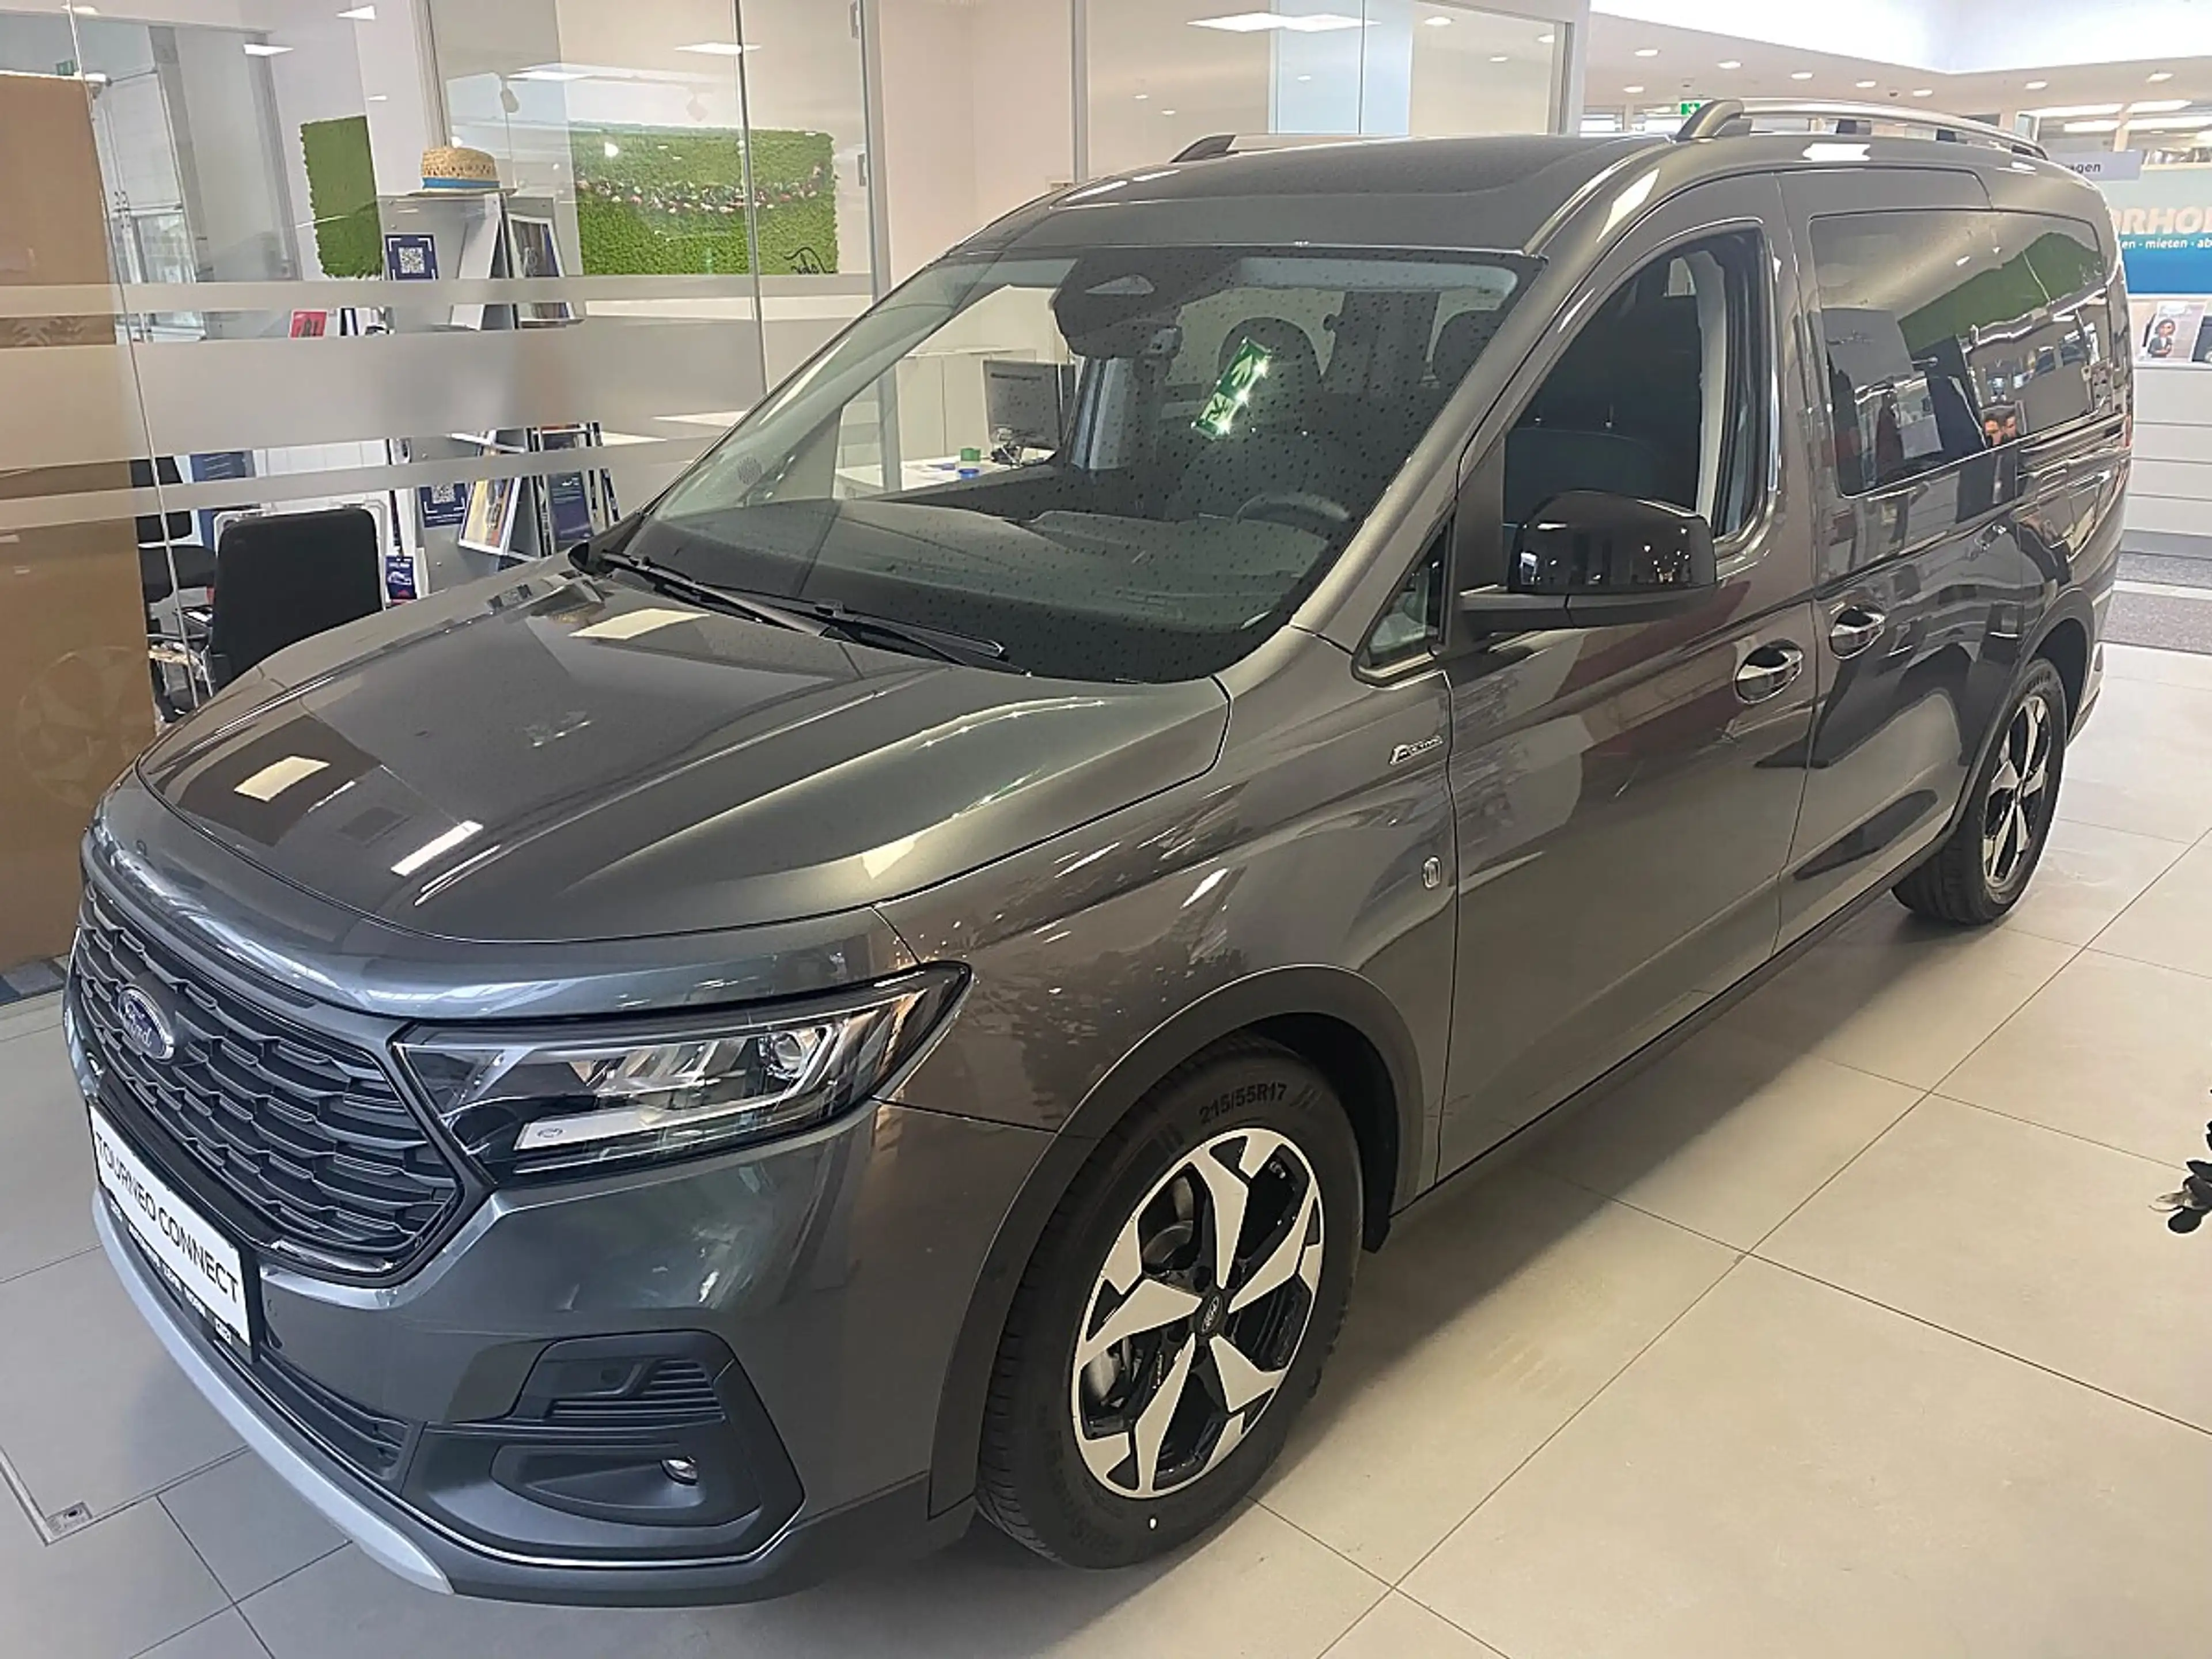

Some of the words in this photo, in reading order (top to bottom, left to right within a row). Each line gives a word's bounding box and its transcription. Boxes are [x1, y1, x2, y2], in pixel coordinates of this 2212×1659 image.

[2146, 238, 2187, 248] mieten
[1199, 1082, 1287, 1124] 215/55R17
[95, 1131, 156, 1221] TOURNEO
[158, 1206, 238, 1304] CONNECT
